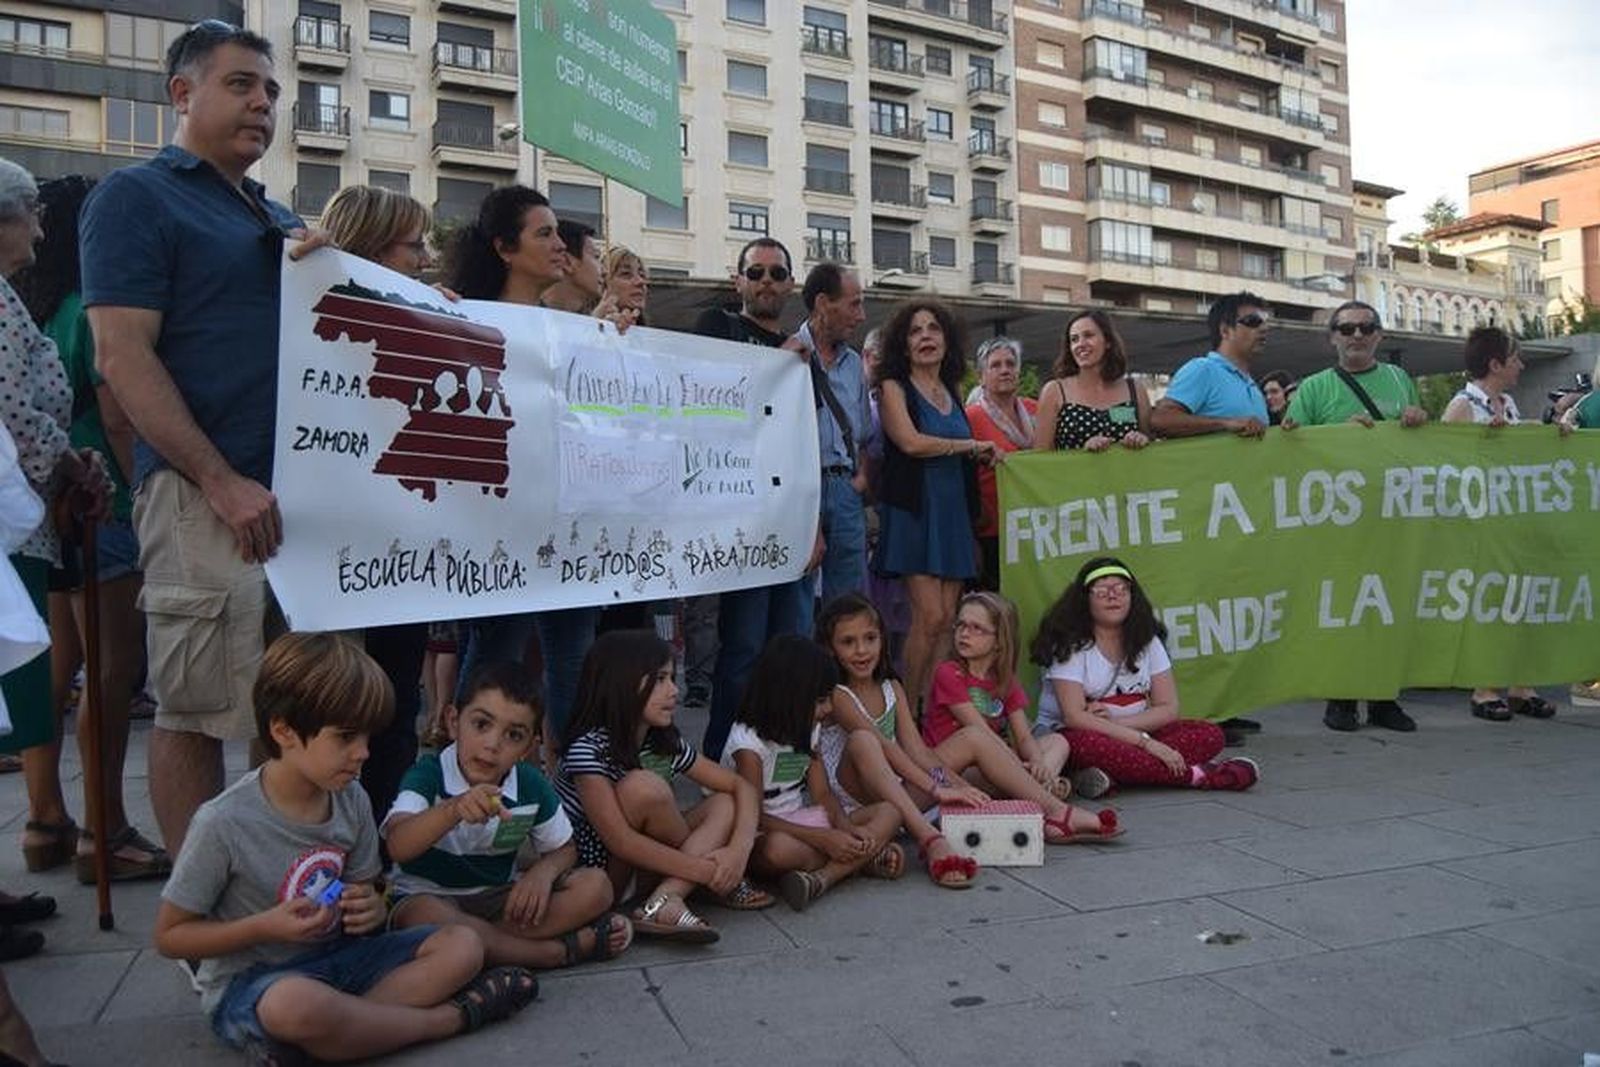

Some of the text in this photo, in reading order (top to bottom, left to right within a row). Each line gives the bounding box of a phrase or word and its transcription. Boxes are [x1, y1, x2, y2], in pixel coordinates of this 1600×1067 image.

[302, 368, 366, 400] F.A.P.A.
[292, 426, 369, 458] ZAMORA
[1004, 489, 1182, 564] FRENTE
[1207, 482, 1255, 538] A
[1274, 469, 1366, 529] LOS
[1381, 458, 1577, 521] RECORTES
[338, 546, 790, 597] ESCUELA PÚBLICA: DE TOD@S PARA TOD@S
[1318, 573, 1394, 628] LA
[1416, 568, 1594, 624] ESCUELA
